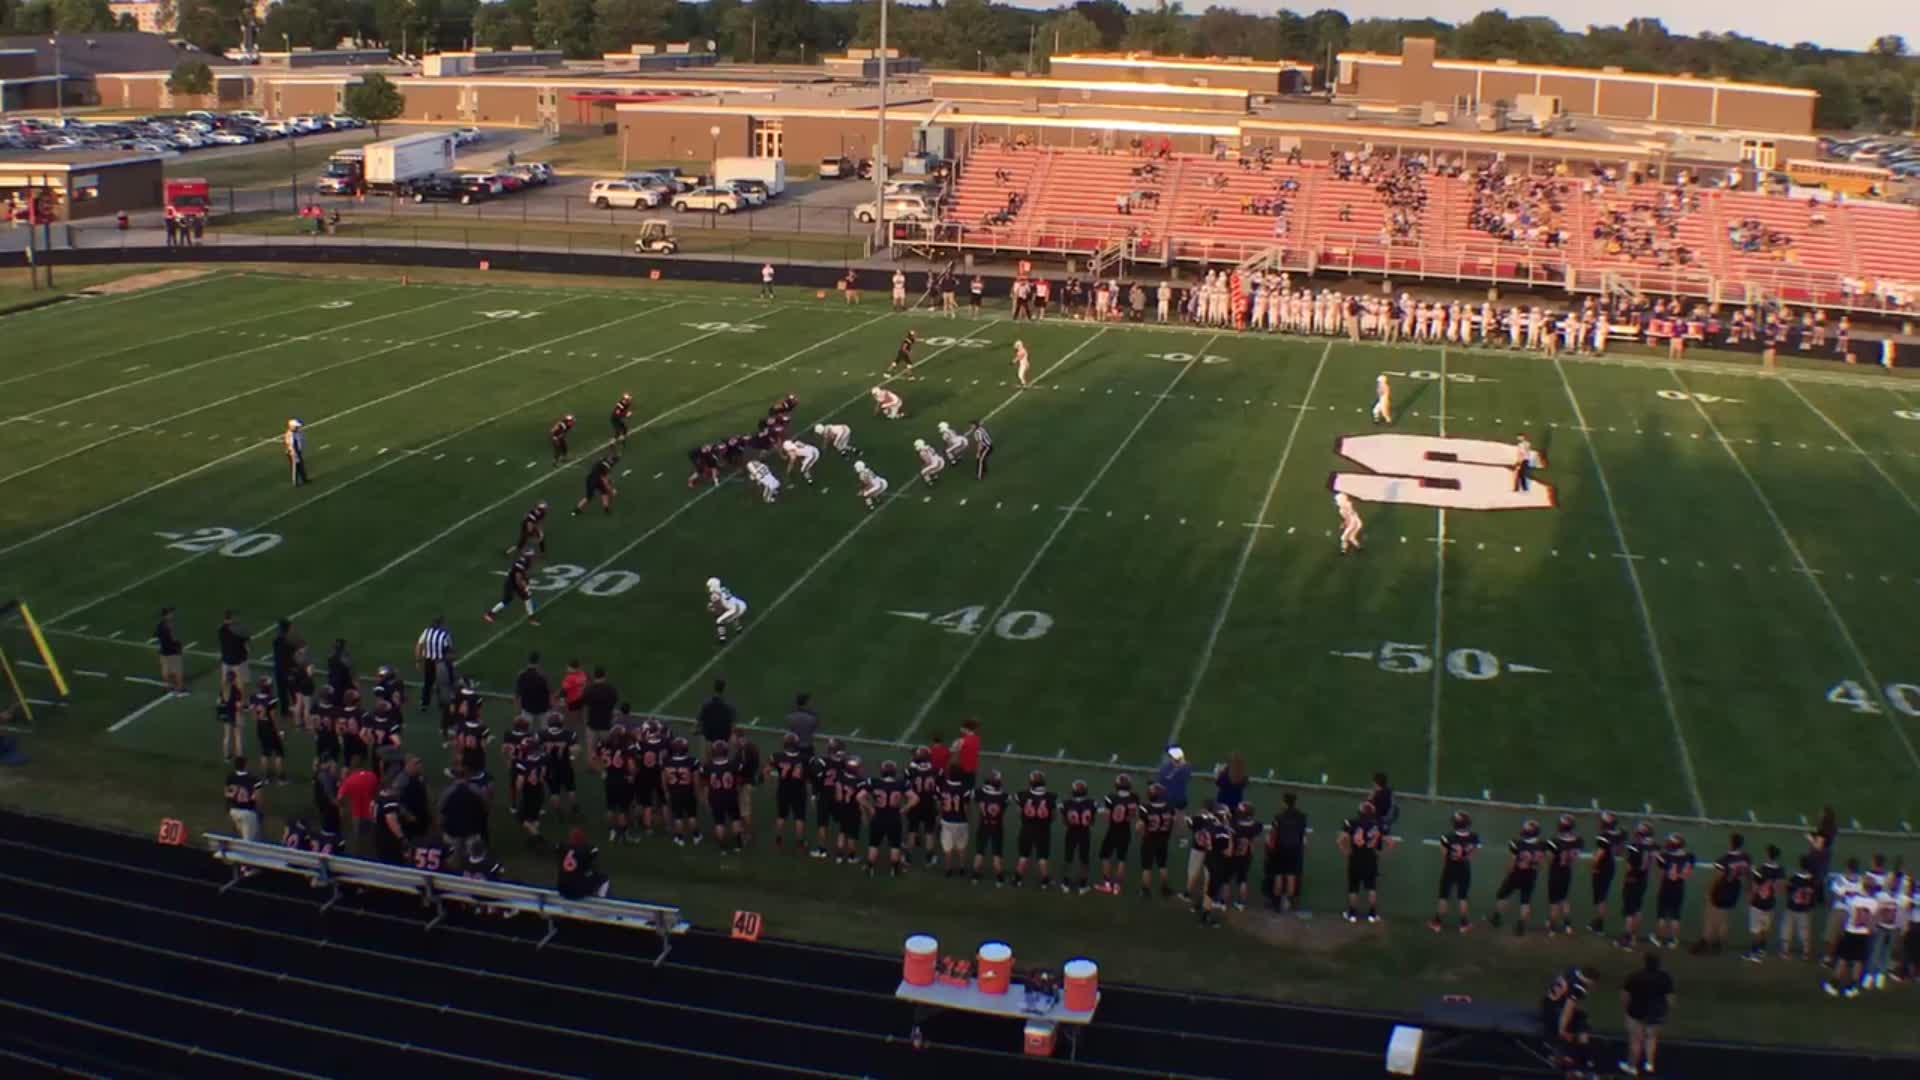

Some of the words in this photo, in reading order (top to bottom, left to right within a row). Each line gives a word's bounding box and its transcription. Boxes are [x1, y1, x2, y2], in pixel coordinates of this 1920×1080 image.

[164, 527, 281, 558] 20
[527, 563, 641, 596] 30
[929, 604, 1055, 641] 40
[1376, 640, 1500, 681] 50
[1825, 680, 1920, 717] 40
[413, 847, 443, 870] 55
[562, 848, 577, 873] 6
[736, 911, 758, 935] 40
